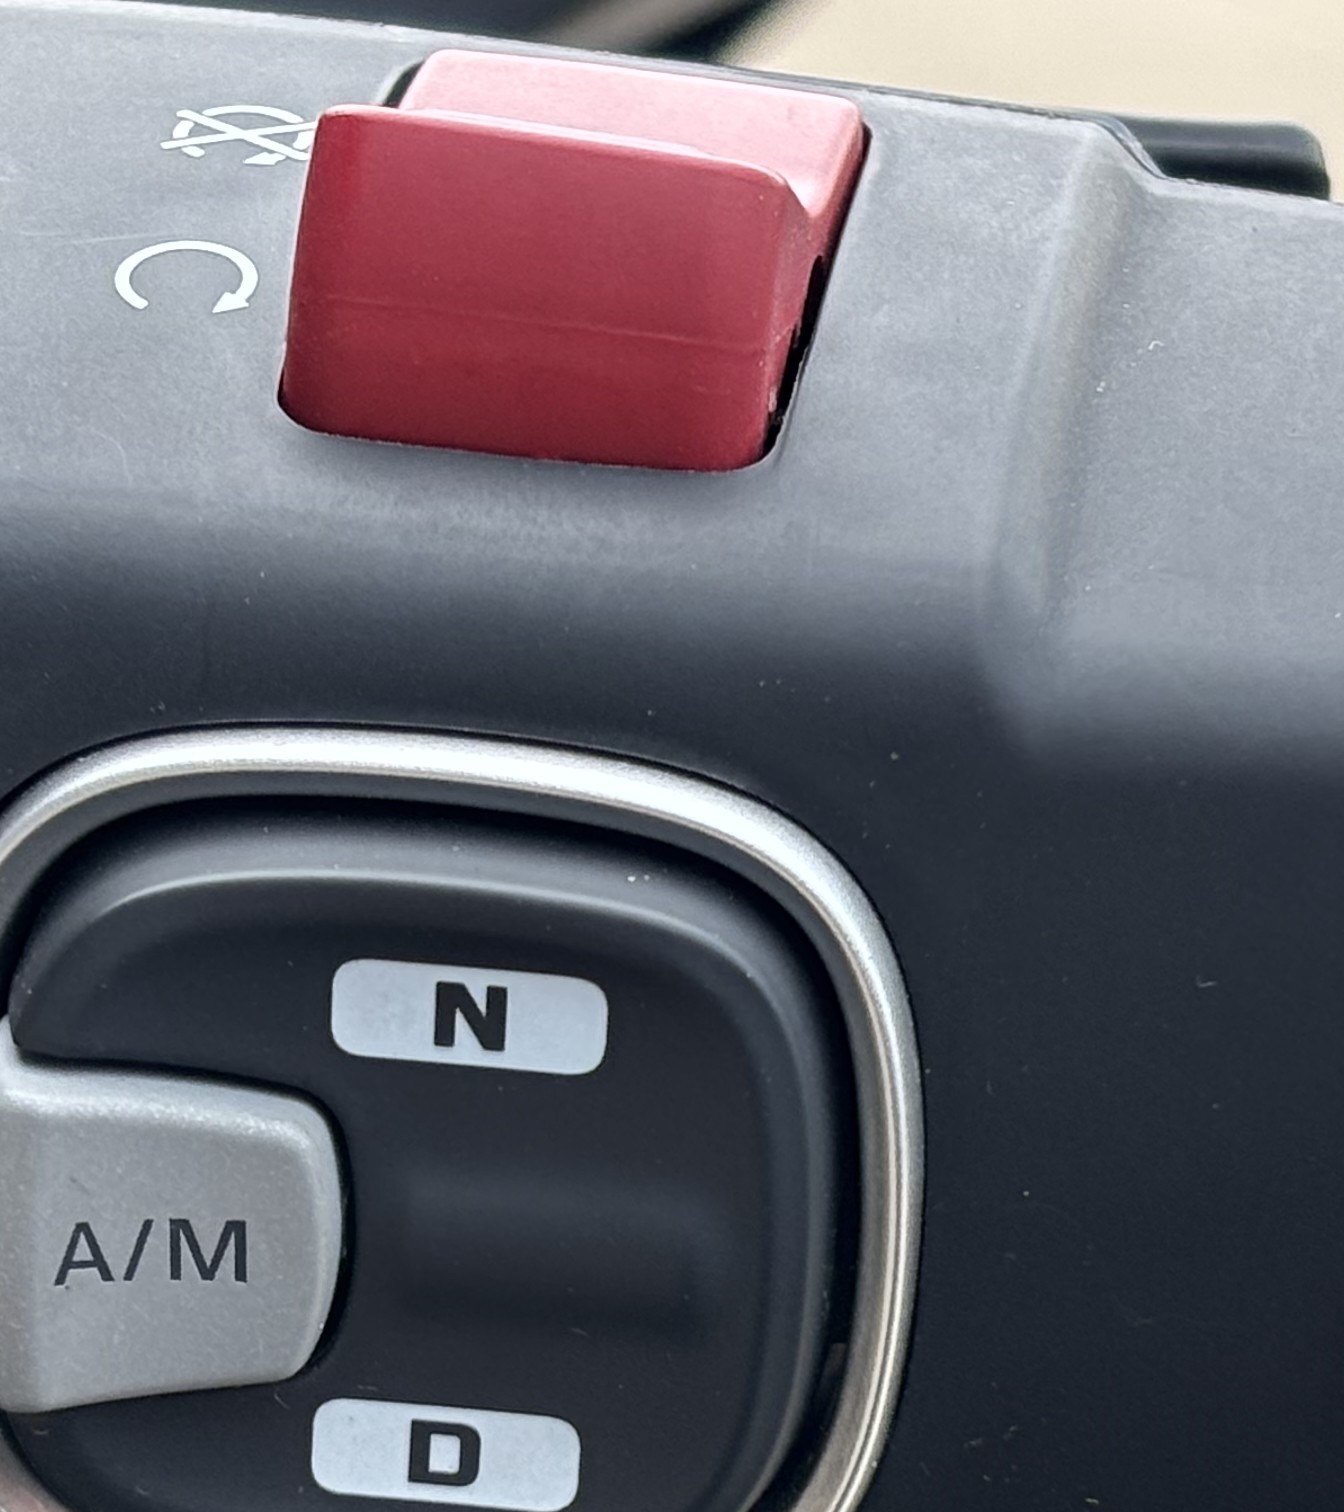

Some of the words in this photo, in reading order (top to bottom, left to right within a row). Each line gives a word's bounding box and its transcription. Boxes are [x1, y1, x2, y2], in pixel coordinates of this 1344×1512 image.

[433, 980, 508, 1052] N
[53, 1217, 248, 1287] A/M
[407, 1418, 482, 1488] D
